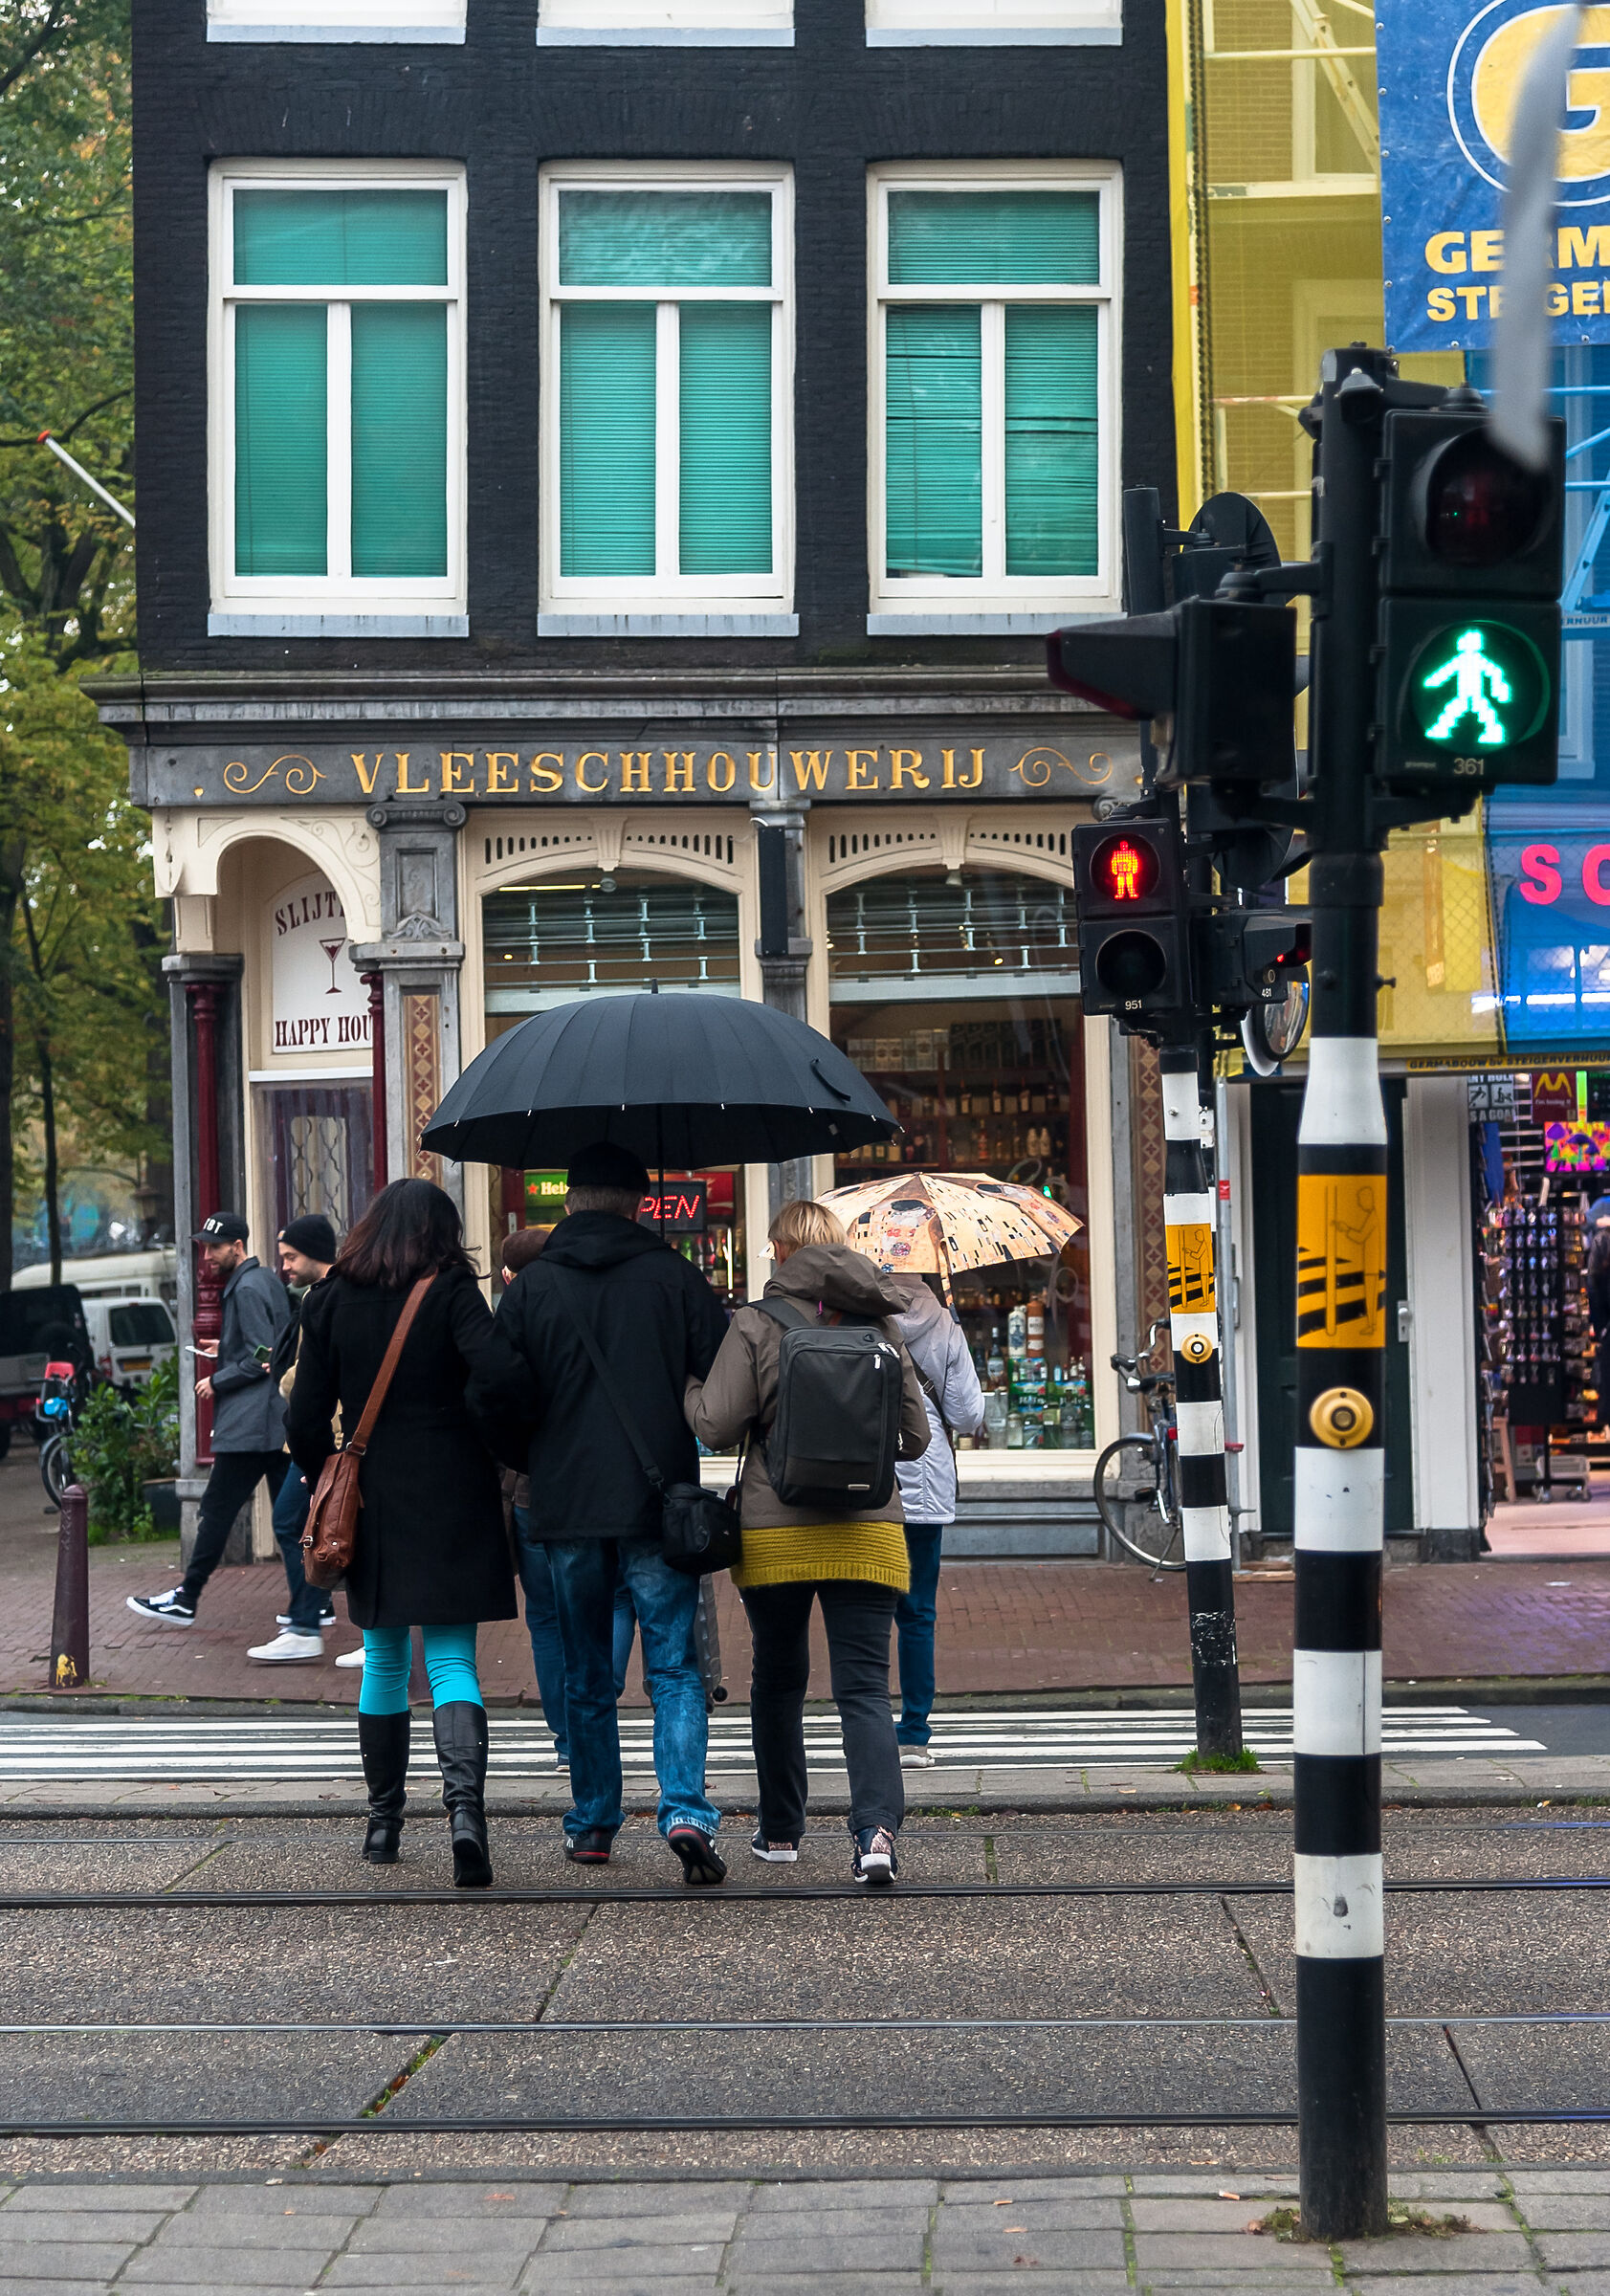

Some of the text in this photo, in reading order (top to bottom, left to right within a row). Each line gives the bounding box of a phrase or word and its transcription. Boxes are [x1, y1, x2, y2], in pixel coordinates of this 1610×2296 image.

[1425, 225, 1610, 274] GEM
[350, 747, 986, 795] VLEESCHHOUWERIJ
[1453, 758, 1484, 775] 361
[1261, 988, 1272, 998] 481
[1125, 1000, 1142, 1010] 951
[276, 1017, 330, 1047] HAPPY
